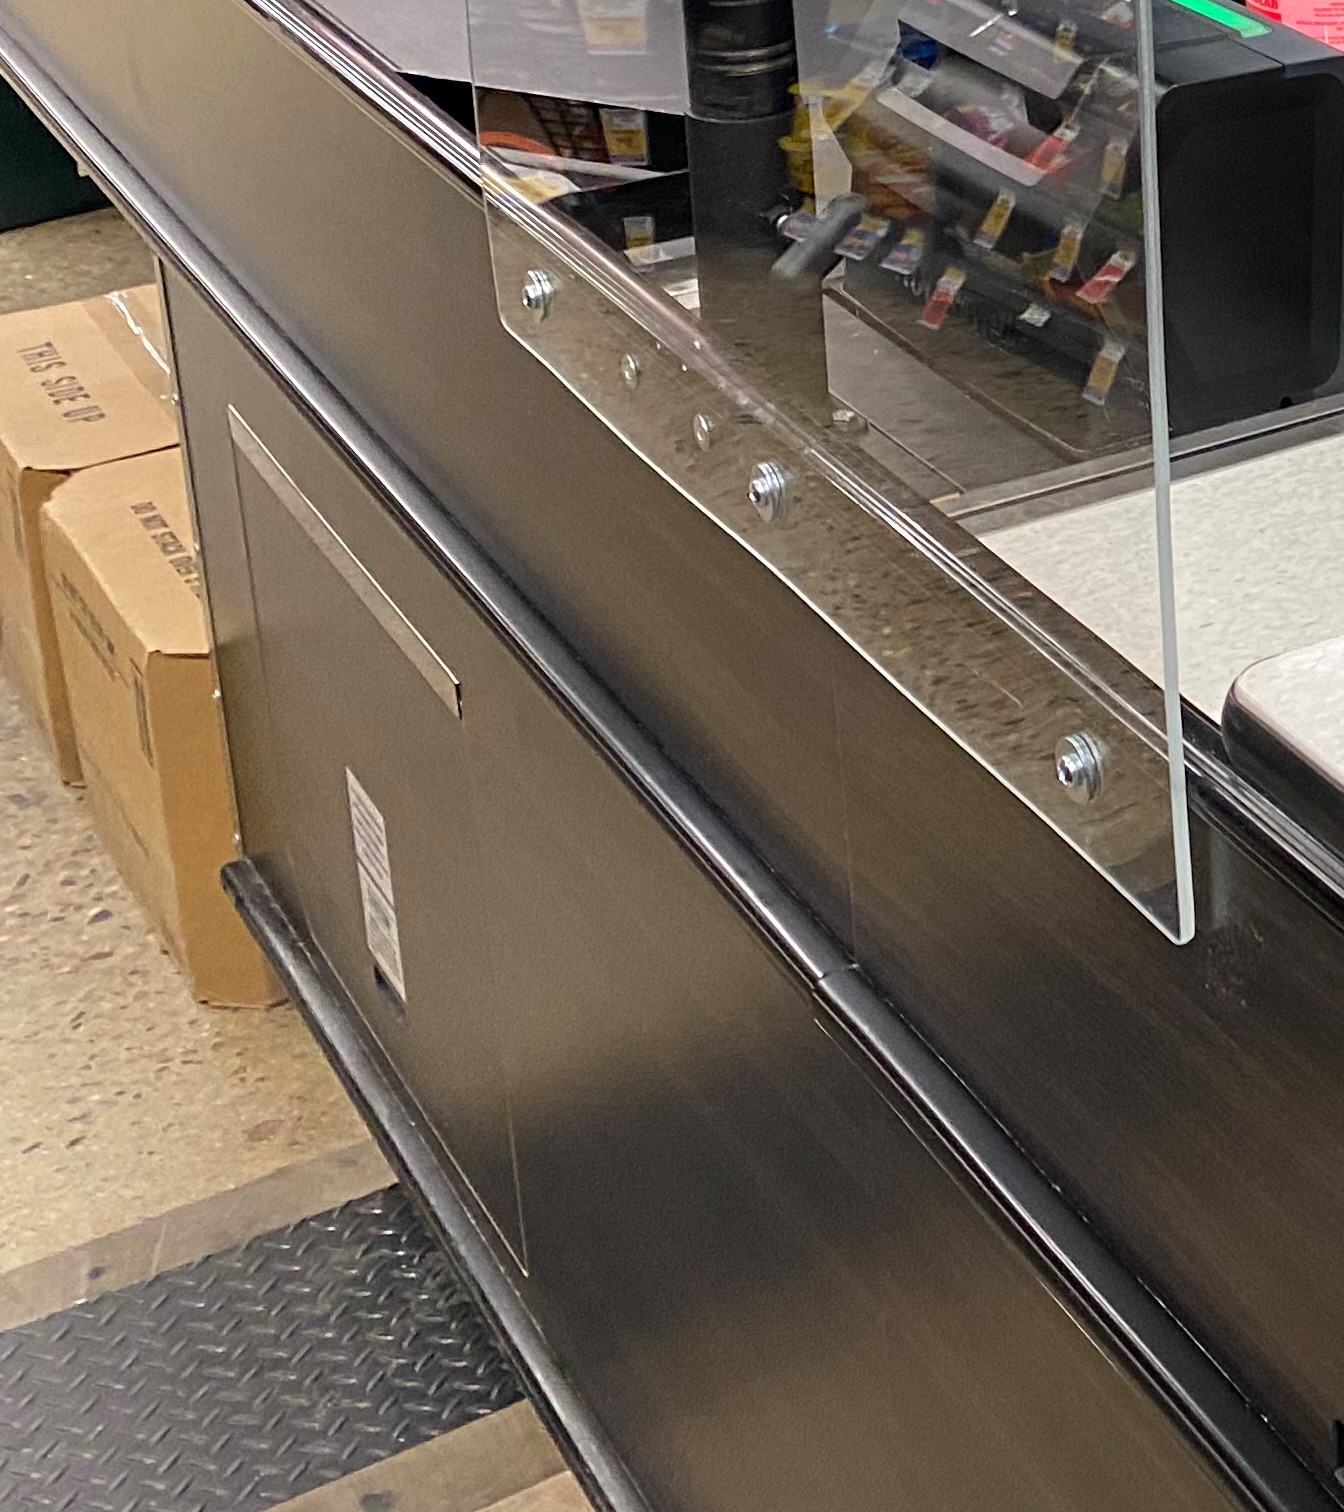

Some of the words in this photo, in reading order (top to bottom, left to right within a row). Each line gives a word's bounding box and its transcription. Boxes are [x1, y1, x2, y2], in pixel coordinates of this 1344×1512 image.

[18, 341, 67, 373] THIS
[41, 376, 91, 405] SIDE
[63, 405, 106, 423] UP
